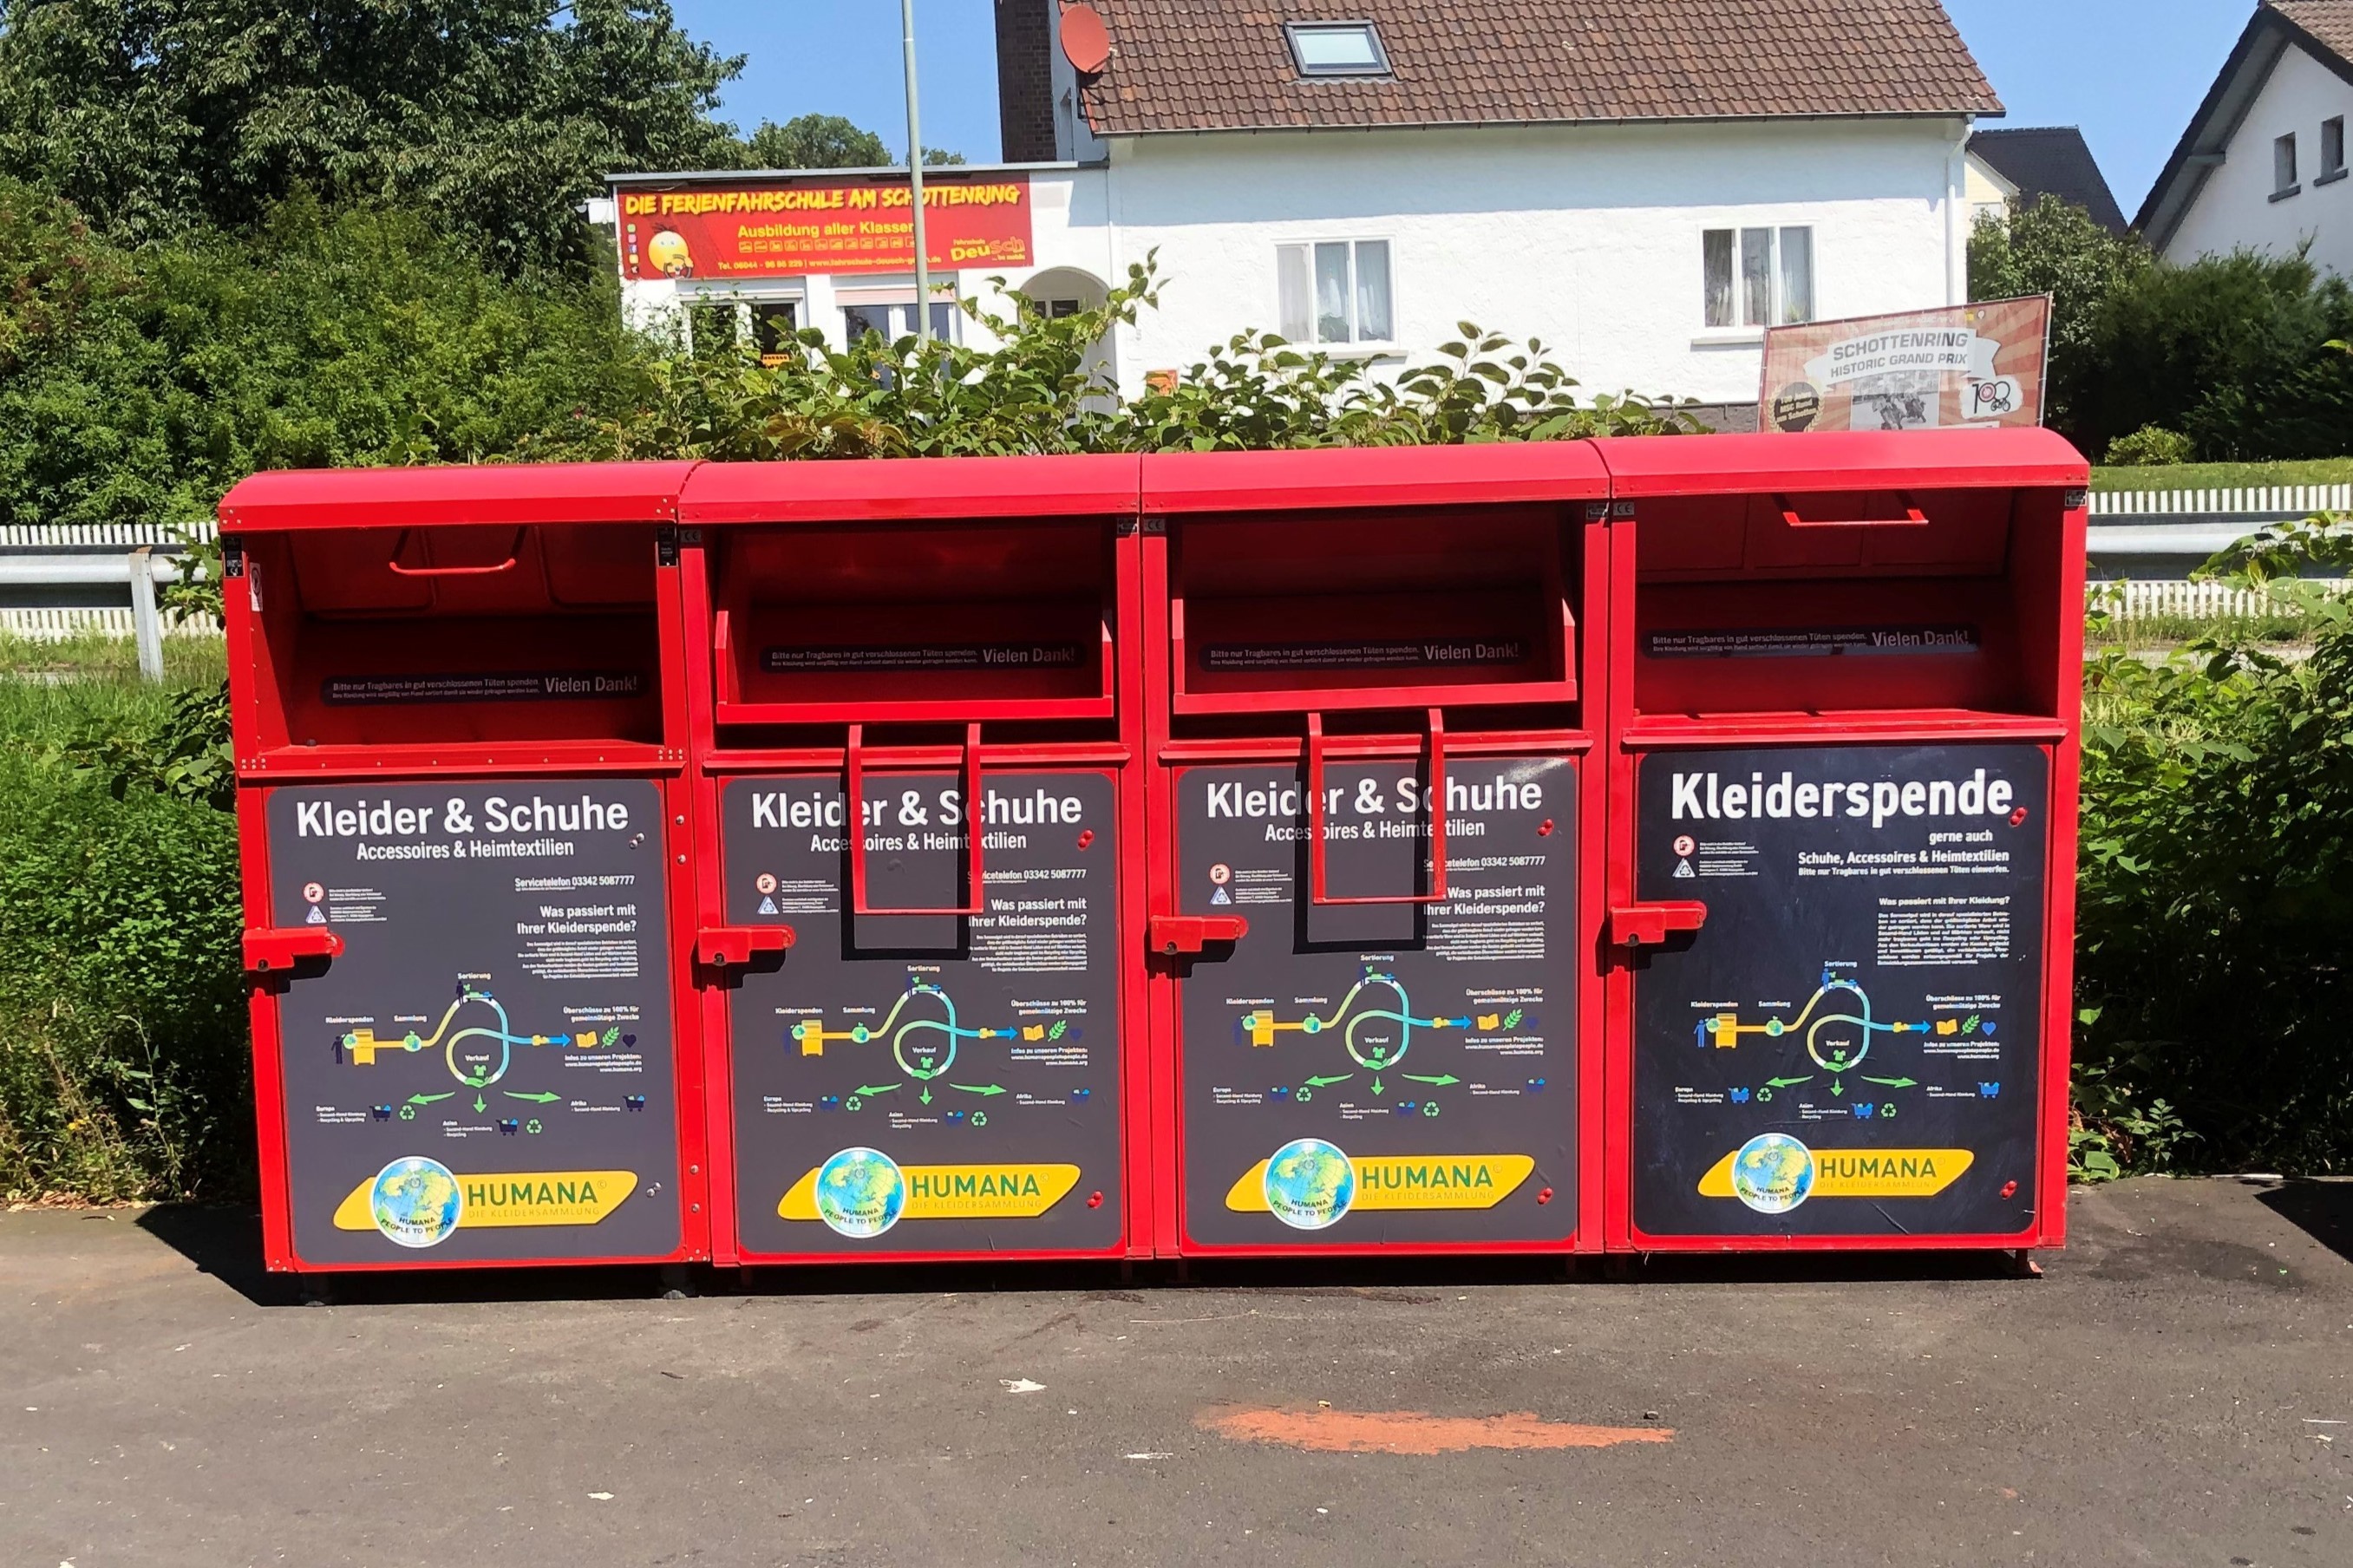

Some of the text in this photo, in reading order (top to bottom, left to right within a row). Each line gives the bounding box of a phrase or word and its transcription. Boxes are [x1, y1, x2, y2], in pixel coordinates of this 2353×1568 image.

[625, 195, 657, 215] DIE
[661, 189, 844, 215] FERIENFAHRSCHULE
[848, 188, 877, 210] AM
[738, 225, 819, 238] Ausbildung
[824, 223, 854, 235] aller
[1833, 332, 1968, 361] SCHOTTENRING
[1831, 353, 1968, 378] HISTORIC GRAND PRIX
[1652, 636, 1671, 644] Bitte
[1687, 635, 1725, 644] Tragbares
[1873, 631, 1919, 647] Vielen
[1924, 630, 1969, 645] Dank!
[983, 647, 1074, 663] Vielen Dank!
[1245, 649, 1281, 658] Tragbares
[1424, 644, 1471, 660] Vielen
[1475, 643, 1518, 658] Dank!
[367, 682, 403, 690] Tragbares
[545, 677, 590, 693] Vielen
[595, 676, 637, 691] Dank!
[1355, 778, 1385, 814] &
[1671, 768, 2013, 828] Kleiderspende
[297, 795, 628, 837] Kleider & Schuhe
[899, 790, 929, 826] &
[1265, 819, 1485, 842] Accesoires & Heimtetilien
[1929, 828, 1993, 846] gerne auch
[356, 838, 574, 860] Accessoires & Heimtextilien
[810, 831, 1027, 853] Acceoires & Heimtxtilien
[1480, 855, 1546, 867] 03342 5087777
[1798, 849, 2010, 866] Schuhe, Accessoires & Heimtextilien
[514, 875, 635, 889] Servicetelefon 03342 5087777
[1023, 868, 1087, 880] 03342 5087777
[1447, 885, 1545, 900] Was passiert mit
[990, 897, 1087, 912] Was passiert mit
[1424, 901, 1545, 916] Ihrer Kleiderspende?
[1879, 897, 1897, 905] Was
[1898, 897, 1931, 907] passiert
[1948, 896, 1968, 905] Ihrer
[1969, 895, 2010, 905] Kleidung?
[539, 903, 637, 919] Was passiert mit
[517, 919, 637, 935] Ihrer Kleiderspende?
[968, 913, 1087, 928] Ihrer Kleiderspende?
[1384, 1190, 1494, 1200] KLEIDERSAMMLUNG
[1740, 1186, 1766, 1202] PEOPLE
[1756, 1186, 1790, 1194] HUMANA
[934, 1199, 1042, 1210] KLEIDERSAMMLUNG
[1272, 1199, 1303, 1216] PEOPLE
[1291, 1198, 1329, 1207] HUMANA
[491, 1206, 600, 1218] KLEIDERSAMMLUNG
[824, 1208, 854, 1225] PEOPLE
[842, 1206, 879, 1216] HUMANA
[380, 1218, 409, 1234] PEOPLE
[399, 1216, 436, 1225] HUMANA
